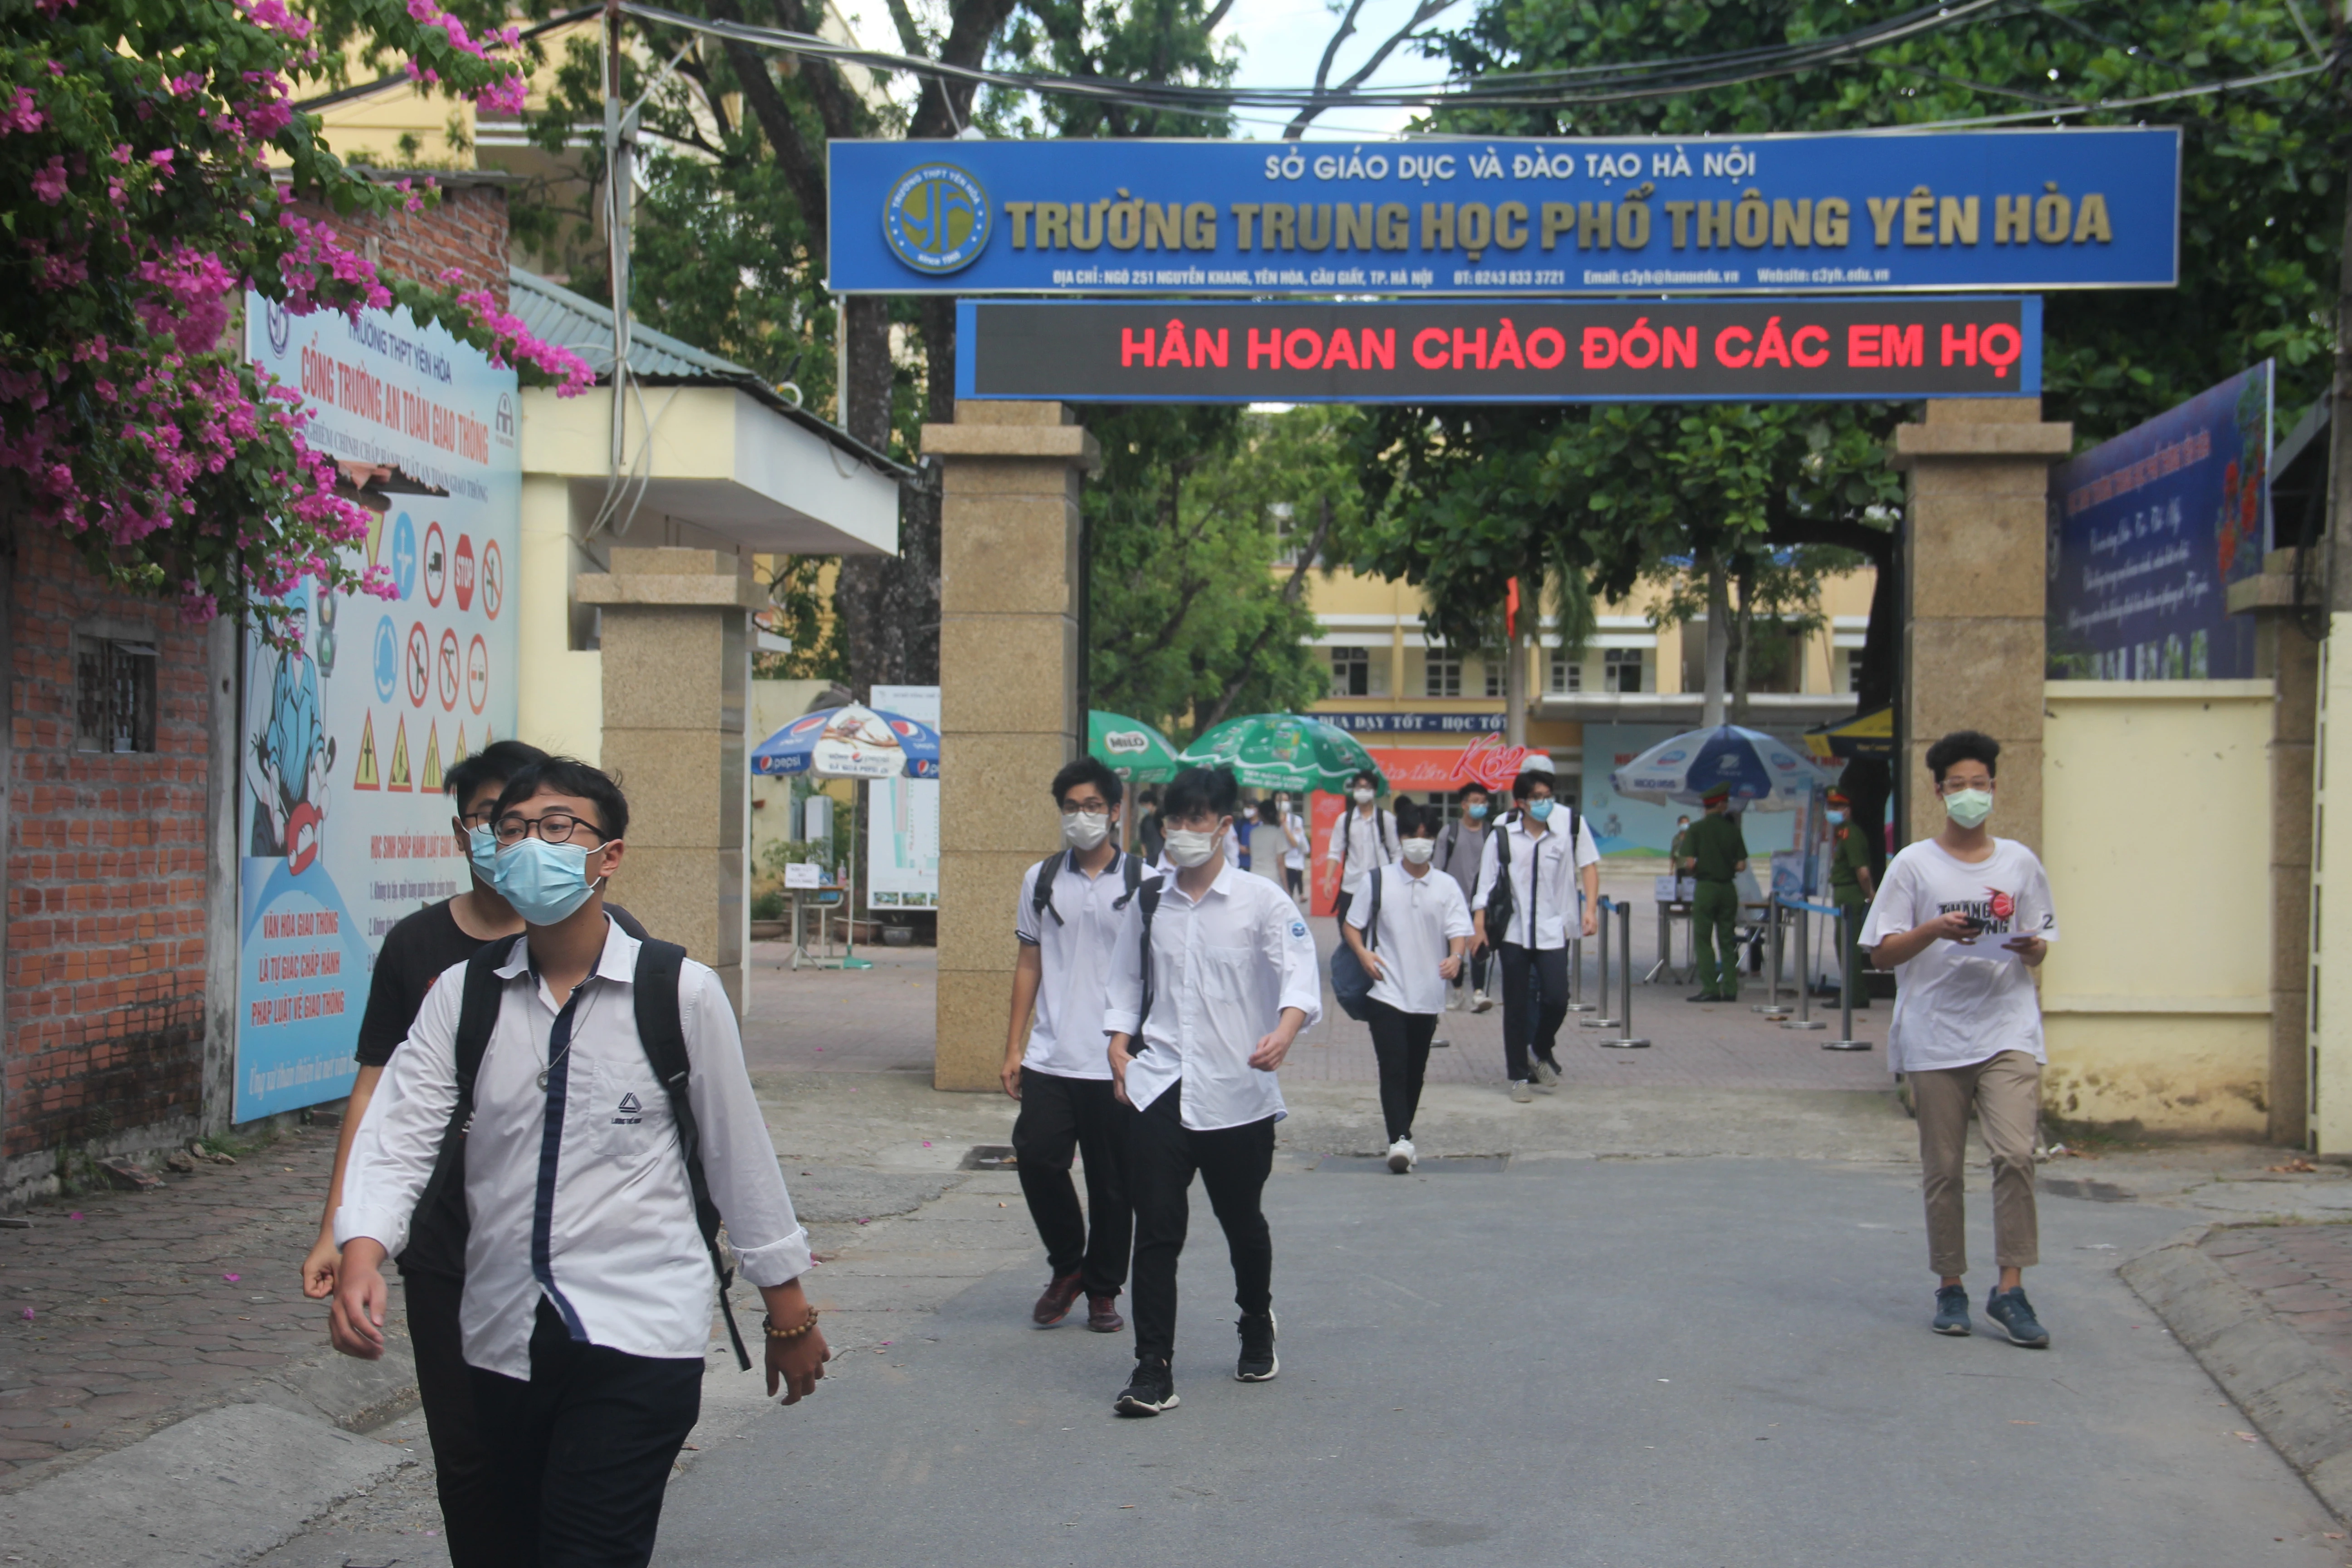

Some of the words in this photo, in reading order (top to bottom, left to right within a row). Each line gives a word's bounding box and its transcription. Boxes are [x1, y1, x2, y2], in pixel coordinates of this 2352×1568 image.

[1265, 147, 1305, 180] SỞ
[1314, 146, 1388, 180] GIÁO
[1399, 155, 1456, 186] DỤC
[1469, 146, 1504, 179] VÀ
[1512, 146, 1574, 179] ĐÀO
[1585, 153, 1642, 186] TẠO
[1652, 144, 1692, 178] HÀ
[1704, 144, 1755, 185] NỘI
[1004, 187, 1217, 250] TRƯỜNG
[1231, 202, 1410, 251] TRUNG
[1421, 201, 1529, 262] HỌC
[1541, 181, 1656, 250] PHỔ
[1665, 187, 1850, 249] THÔNG
[1866, 185, 1980, 246] YÊN
[1994, 181, 2112, 244] HÒA
[1131, 270, 1154, 284] 251
[1156, 265, 1206, 285] NGUYỄN
[1254, 267, 1279, 285] YÊN
[1310, 266, 1336, 285] CẦU
[1370, 270, 1389, 285] TP.
[1390, 268, 1407, 285] HÀ
[1411, 267, 1434, 289] NỘI
[388, 333, 413, 367] THPT
[414, 343, 432, 376] YÊN
[433, 352, 452, 385] HÒA
[1121, 318, 1229, 368] HÂN
[1247, 326, 1396, 370] HOAN
[1412, 317, 1566, 370] CHÀO
[1579, 317, 1698, 369] ĐÓN
[1715, 316, 1830, 368] CÁC
[1848, 323, 1924, 368] EM
[1940, 323, 2022, 378] HỌ
[301, 330, 335, 406] CỔNG
[337, 359, 382, 424] TRƯỜNG
[385, 382, 400, 432] AN
[403, 386, 431, 444] TOÀN
[432, 403, 455, 453] GIAO
[458, 410, 490, 466] THÔNG
[360, 436, 380, 463] CHẤP
[449, 474, 466, 495] GIAO
[466, 477, 489, 504] THÔNG
[456, 555, 473, 589] STOP
[1110, 736, 1145, 748] MILO
[1391, 712, 1425, 730] TỐT
[1442, 715, 1475, 733] HỌC
[773, 754, 801, 770] pepsi
[1449, 731, 1528, 794] K62
[263, 910, 279, 940] VĂN
[280, 908, 296, 938] HÓA
[297, 912, 314, 937] GIAO
[315, 906, 339, 936] THÔNG
[2042, 913, 2054, 930] 2
[259, 952, 269, 983] LÀ
[270, 954, 282, 987] TỰ
[282, 949, 299, 980] GIÁC
[300, 945, 320, 978] CHẤP
[321, 947, 340, 975] HÀNH
[251, 995, 272, 1027] PHÁP
[274, 992, 293, 1028] LUẬT
[293, 988, 303, 1020] VỀ
[304, 993, 321, 1019] GIAO
[322, 986, 345, 1016] THÔNG
